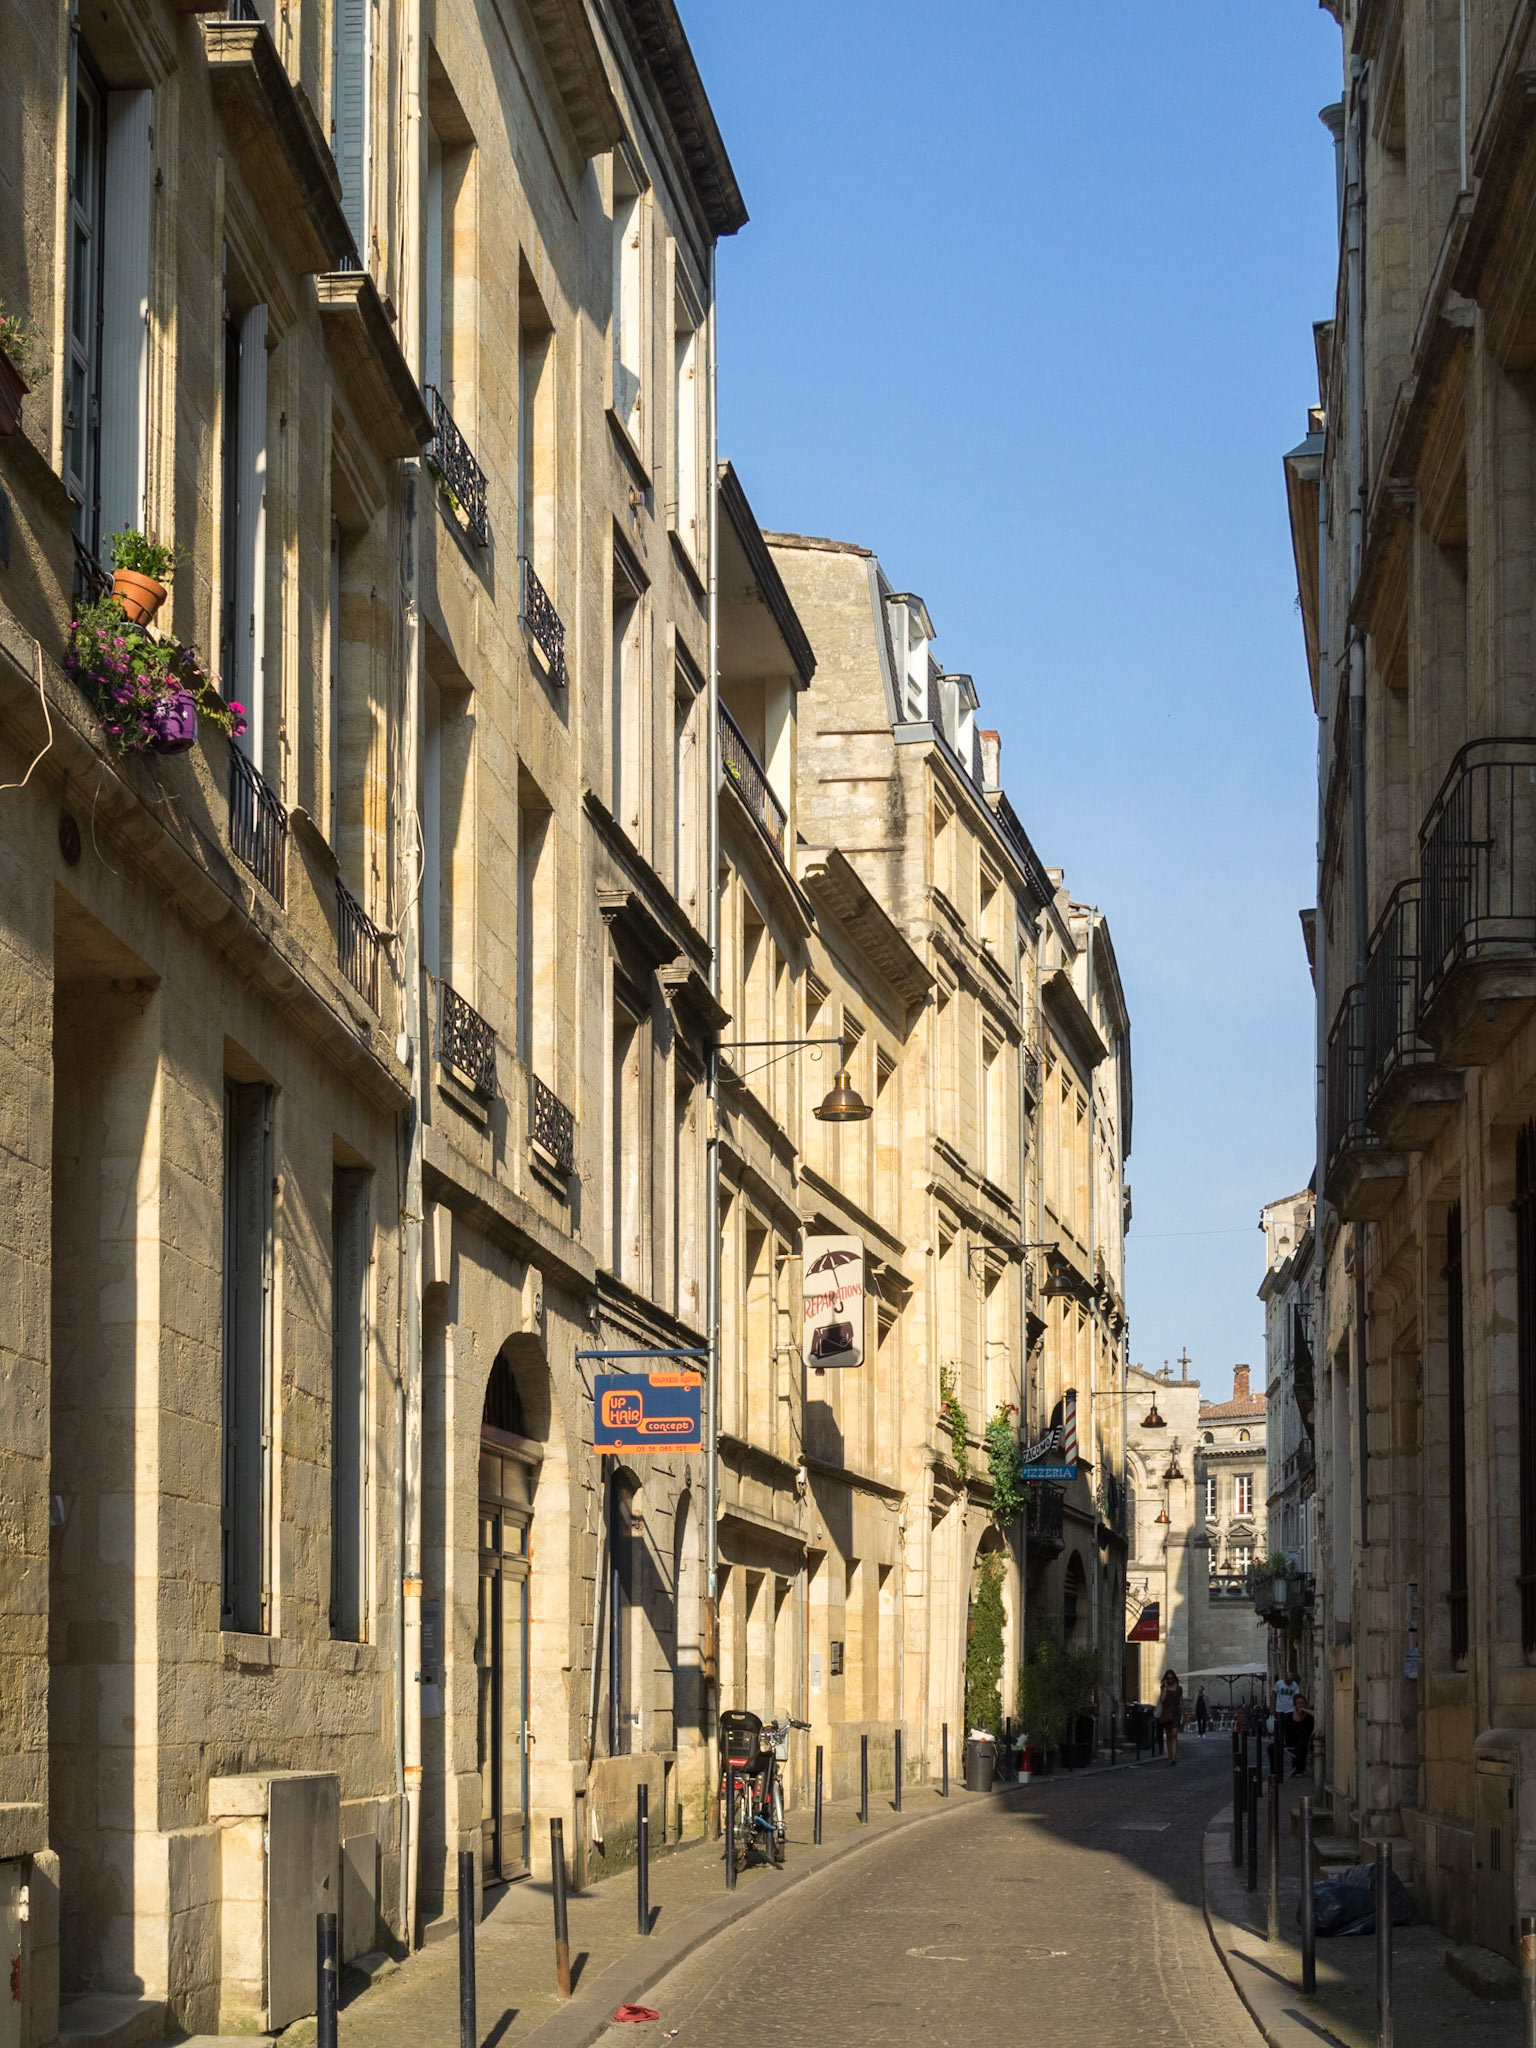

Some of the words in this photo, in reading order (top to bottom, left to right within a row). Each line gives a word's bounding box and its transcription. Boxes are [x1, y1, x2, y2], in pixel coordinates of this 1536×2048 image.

[803, 1284, 862, 1322] REPARATIONS
[610, 1397, 626, 1408] UP
[648, 1422, 689, 1431] concept
